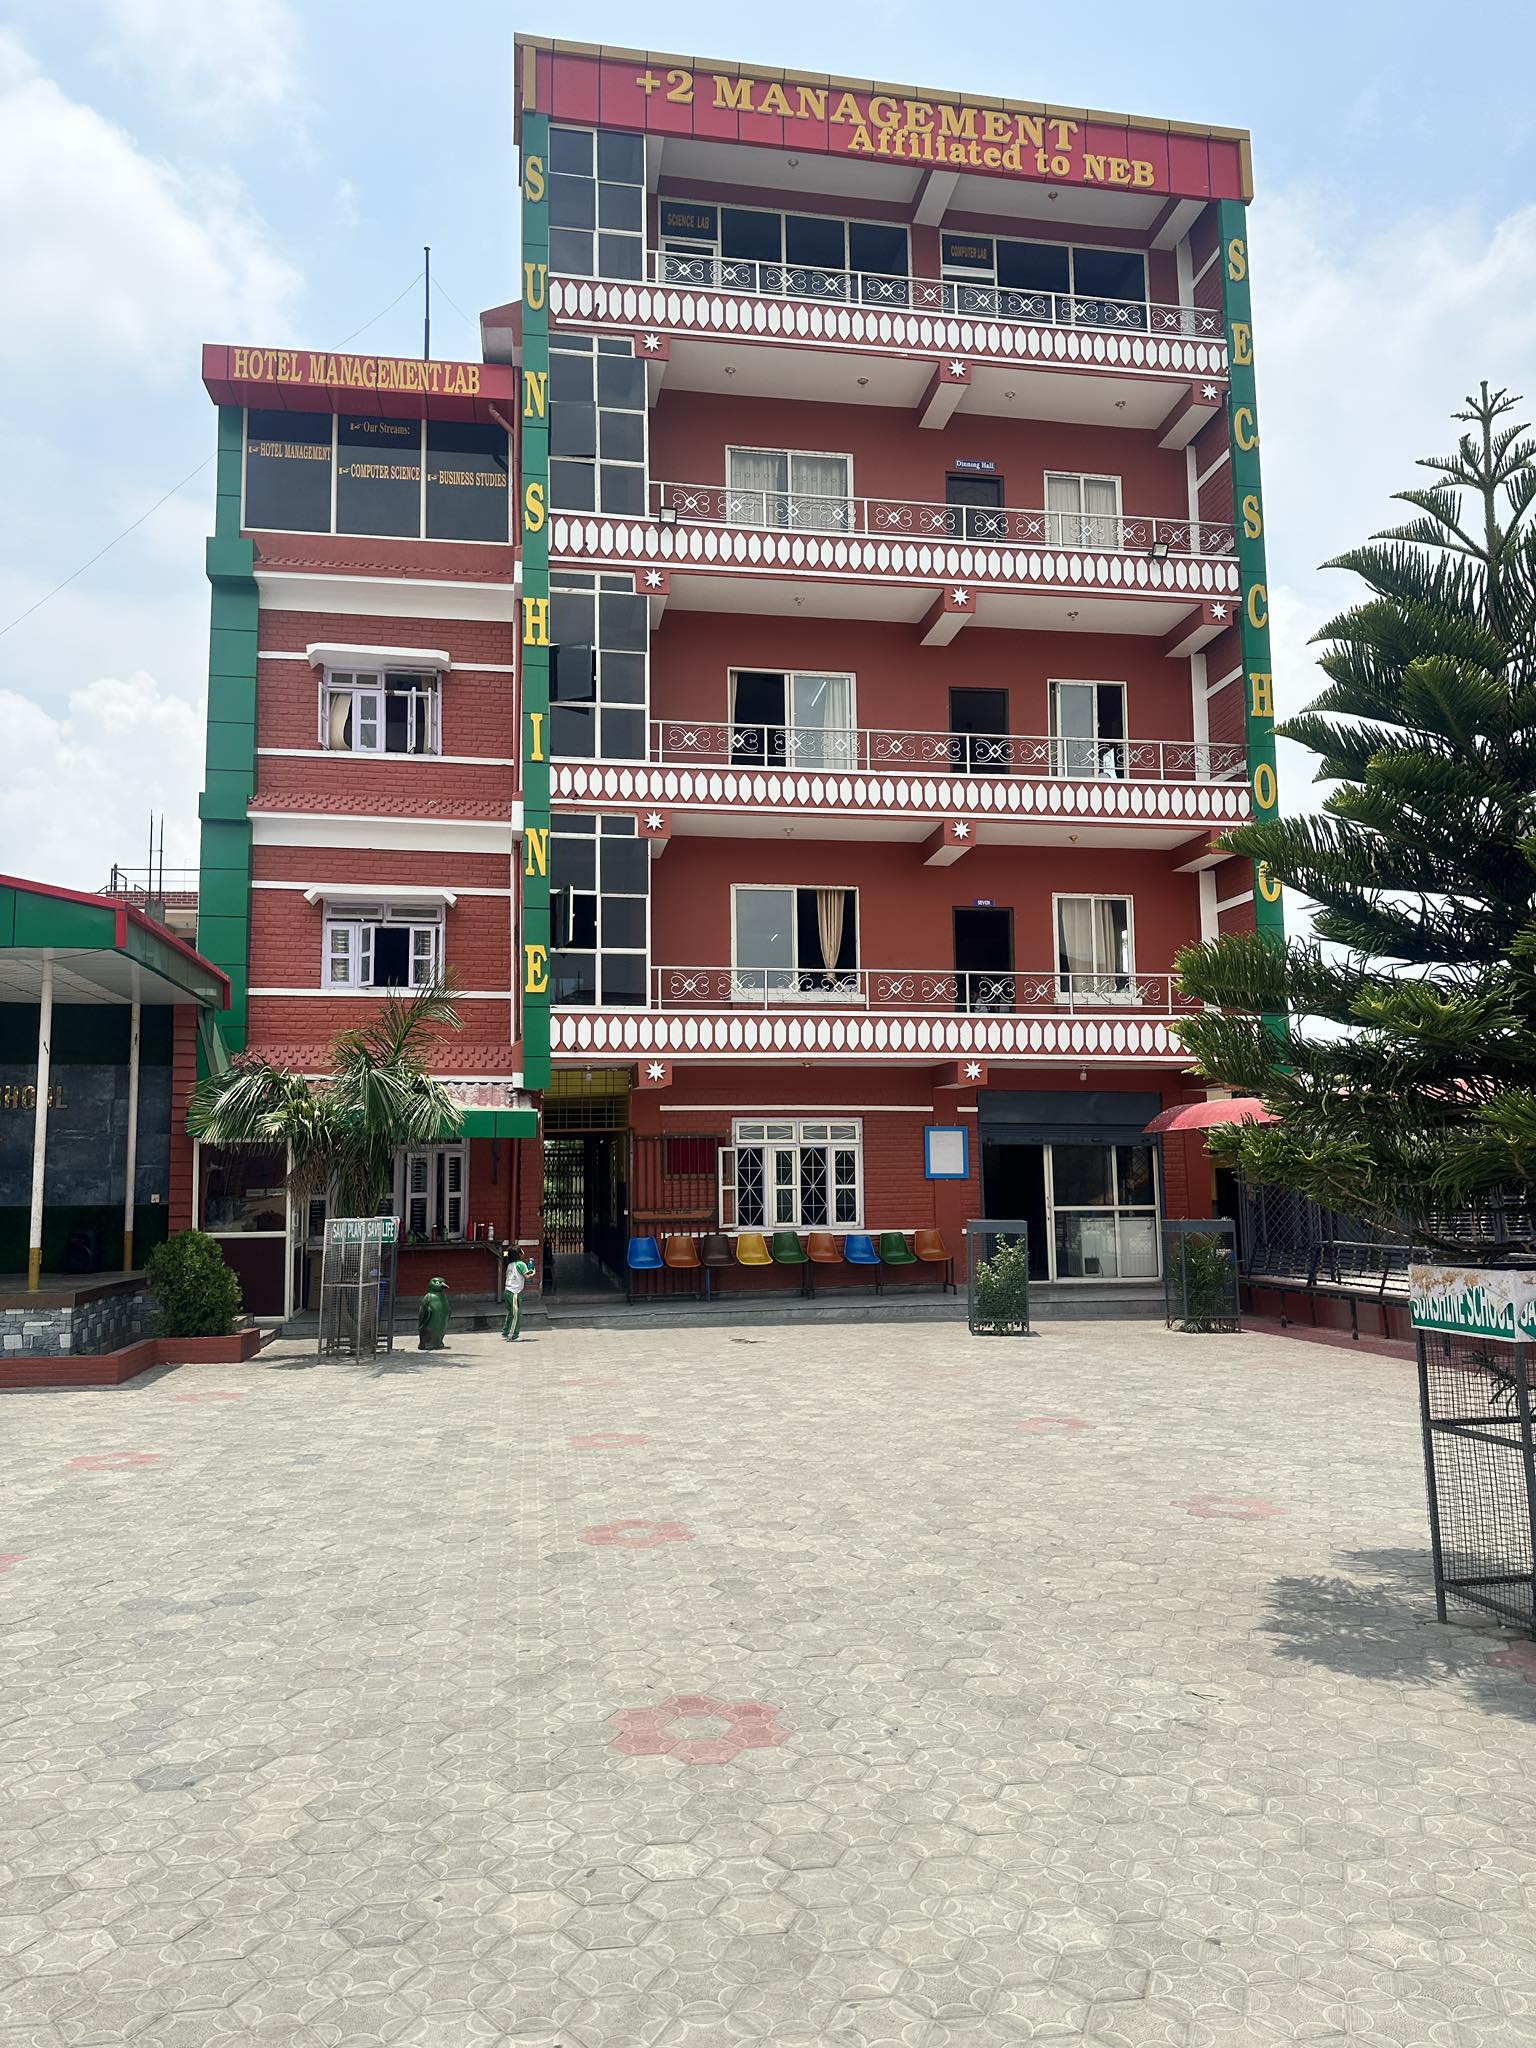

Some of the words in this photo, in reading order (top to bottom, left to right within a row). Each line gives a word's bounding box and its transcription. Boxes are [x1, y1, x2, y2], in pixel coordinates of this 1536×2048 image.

[636, 70, 695, 104] +2
[712, 75, 1078, 151] MANAGEMENT
[848, 125, 1023, 172] Affiliated
[1035, 148, 1070, 176] to
[1083, 153, 1155, 187] NEB
[667, 213, 695, 228] SCIENCE
[697, 215, 710, 229] LAB
[950, 245, 976, 258] COMPUTER
[977, 247, 988, 259] LAB
[233, 349, 302, 381] HOTEL
[309, 354, 442, 392] MANAGEMENT
[444, 363, 481, 395] LAB
[363, 421, 378, 433] Our
[379, 423, 411, 435] Streams:
[260, 443, 283, 458] HOTEL
[284, 444, 331, 460] MANAGEMENT
[350, 463, 389, 479] COMPUTER
[390, 465, 421, 481] SCIENCE
[981, 462, 995, 470] Hall
[439, 470, 474, 486] BUSINESS
[475, 472, 507, 488] STUDIES
[523, 155, 549, 994] SUNSHINE
[382, 1221, 395, 1238] LIFE
